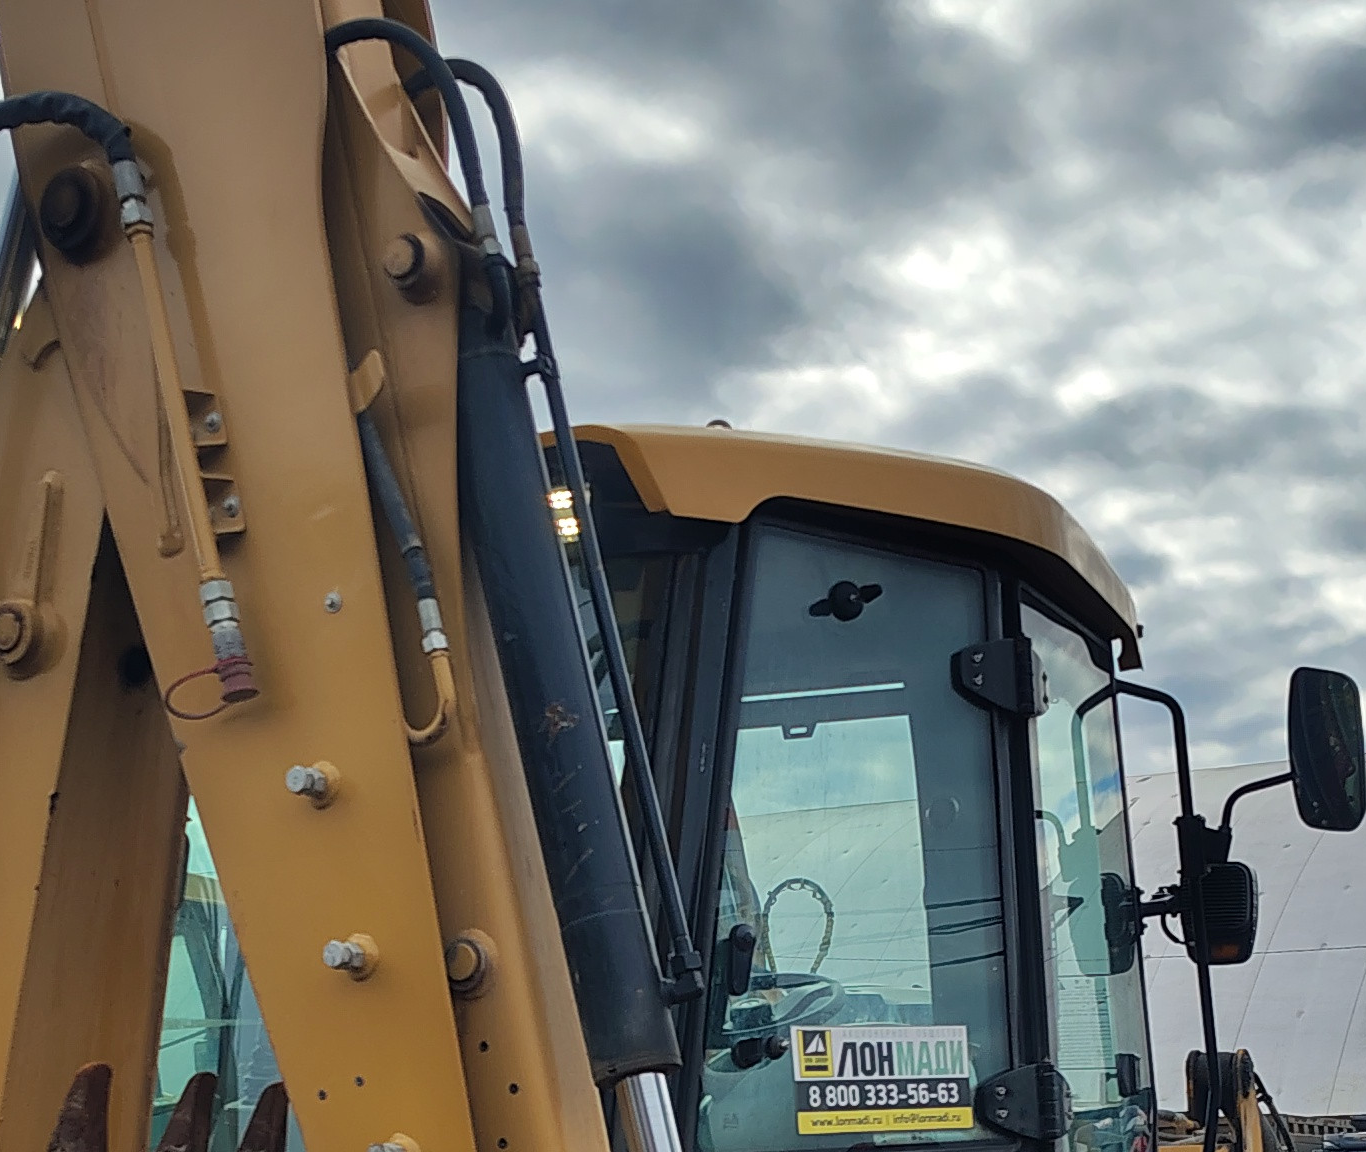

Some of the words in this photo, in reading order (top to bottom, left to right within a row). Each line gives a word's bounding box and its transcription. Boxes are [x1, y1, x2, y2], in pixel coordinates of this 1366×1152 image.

[837, 1040, 964, 1078] ЛОНМАДИ
[808, 1085, 821, 1107] 8
[825, 1084, 860, 1107] 800
[864, 1083, 959, 1106] 333-56-63
